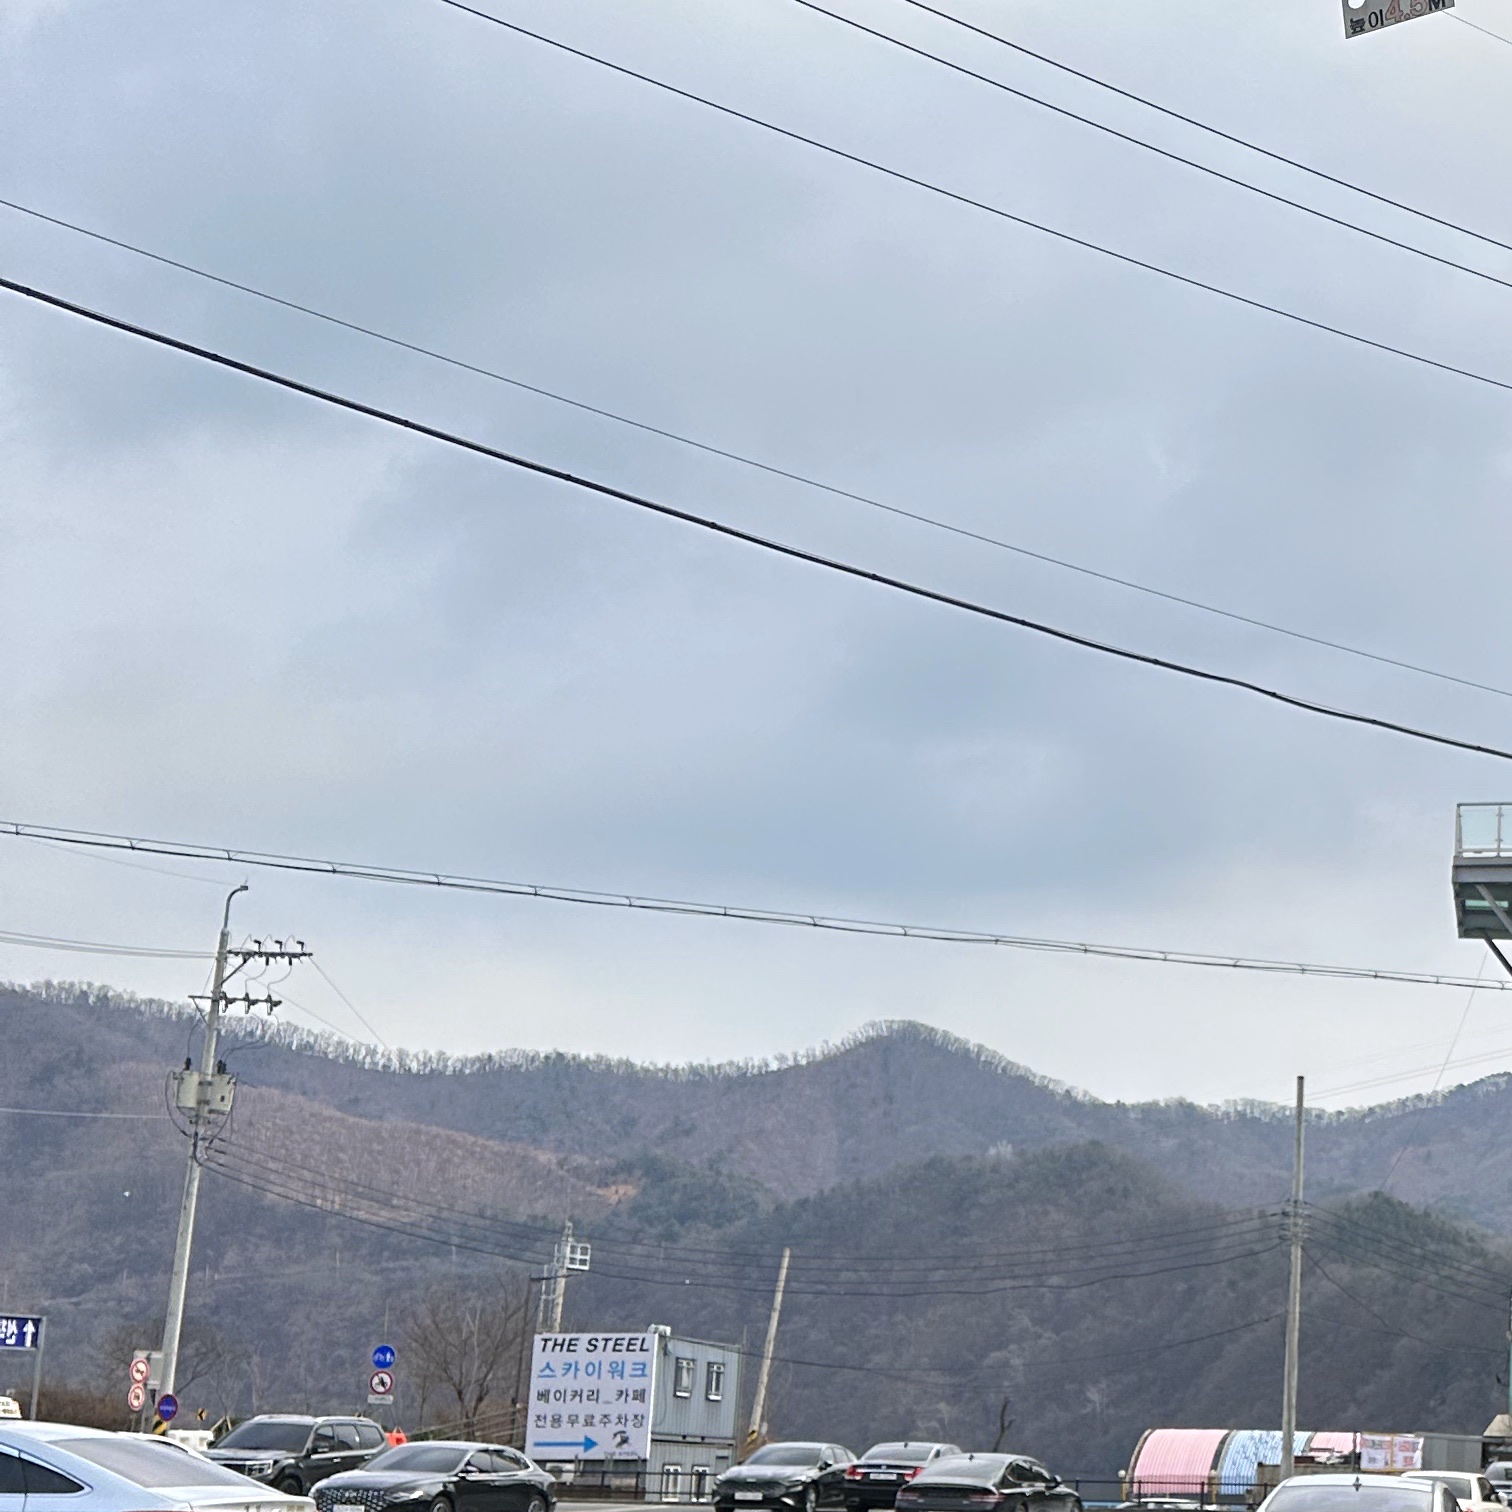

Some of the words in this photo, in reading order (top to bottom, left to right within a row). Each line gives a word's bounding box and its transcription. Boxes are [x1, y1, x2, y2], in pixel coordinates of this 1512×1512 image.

[541, 1337, 580, 1353] THE
[586, 1337, 649, 1353] STEEL
[537, 1360, 648, 1380] 스카이워크
